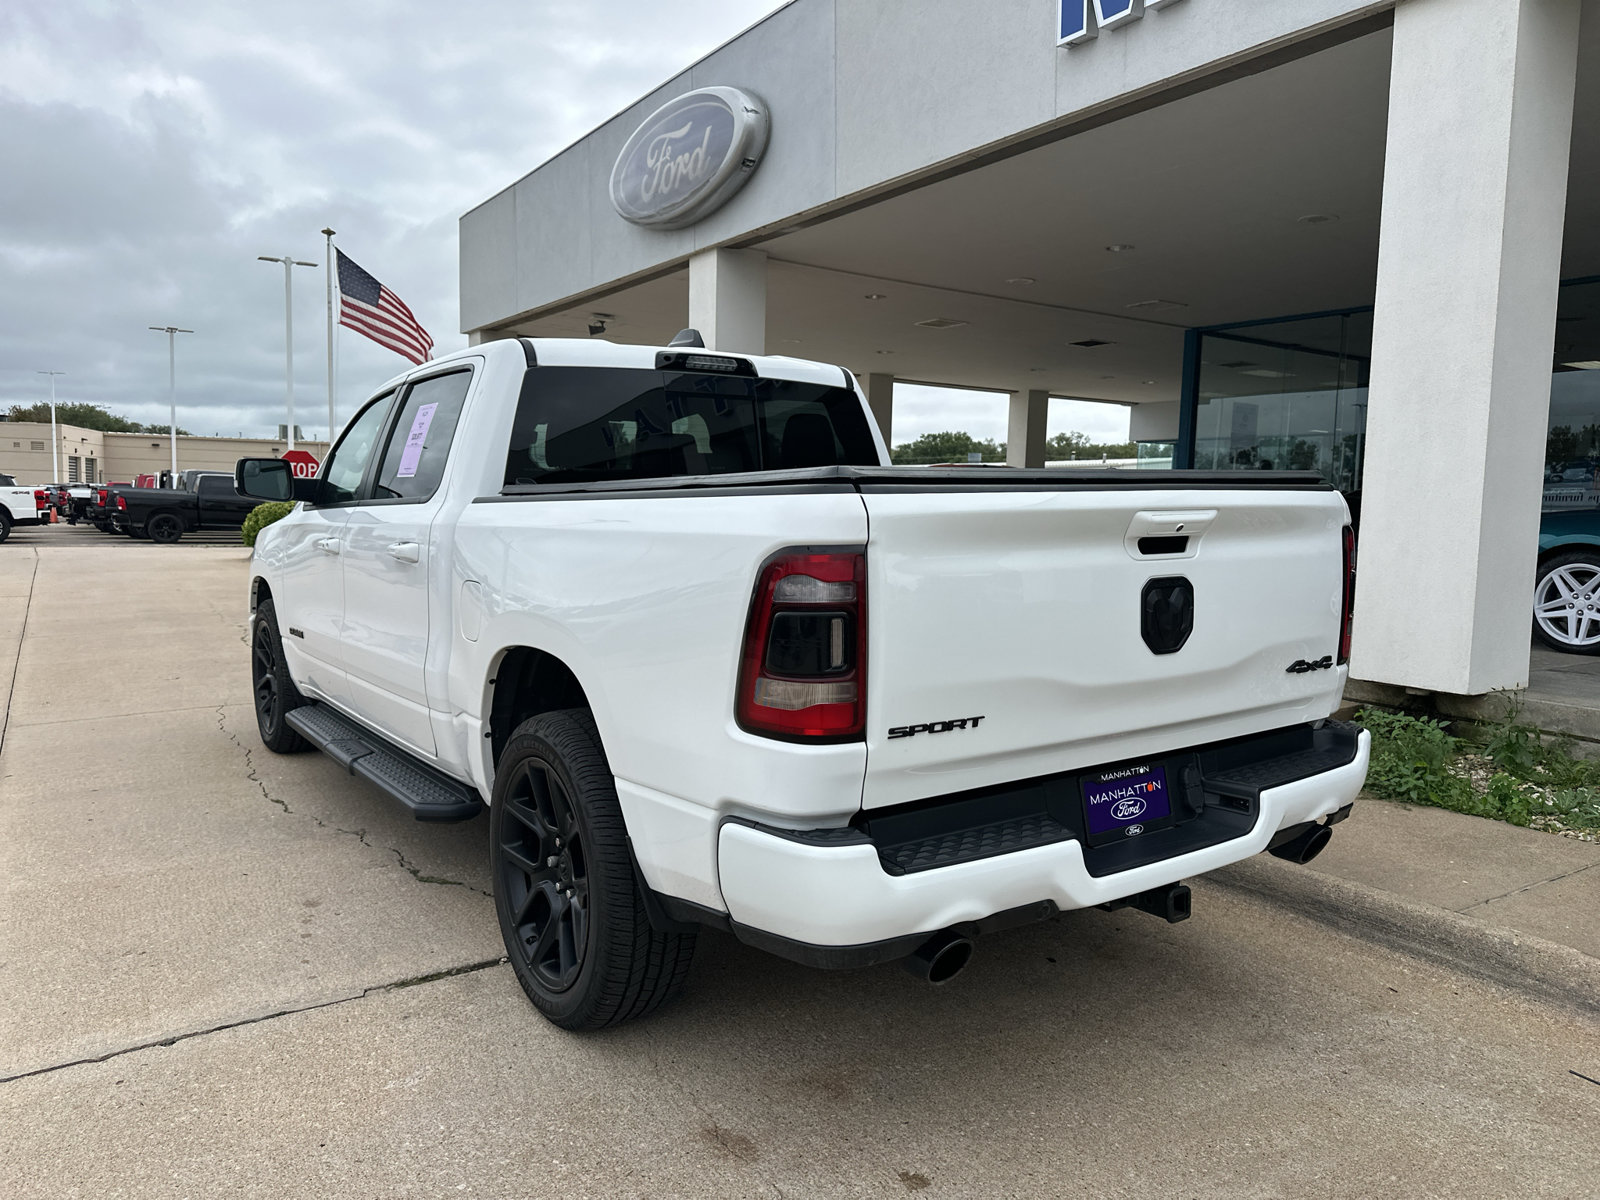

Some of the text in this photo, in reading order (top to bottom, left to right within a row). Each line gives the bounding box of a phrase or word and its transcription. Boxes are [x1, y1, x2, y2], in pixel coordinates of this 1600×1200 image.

[641, 121, 713, 203] Ford
[289, 462, 318, 477] TOP
[887, 715, 986, 740] SPORT
[1117, 800, 1141, 817] Ford
[1128, 825, 1141, 835] Ford
